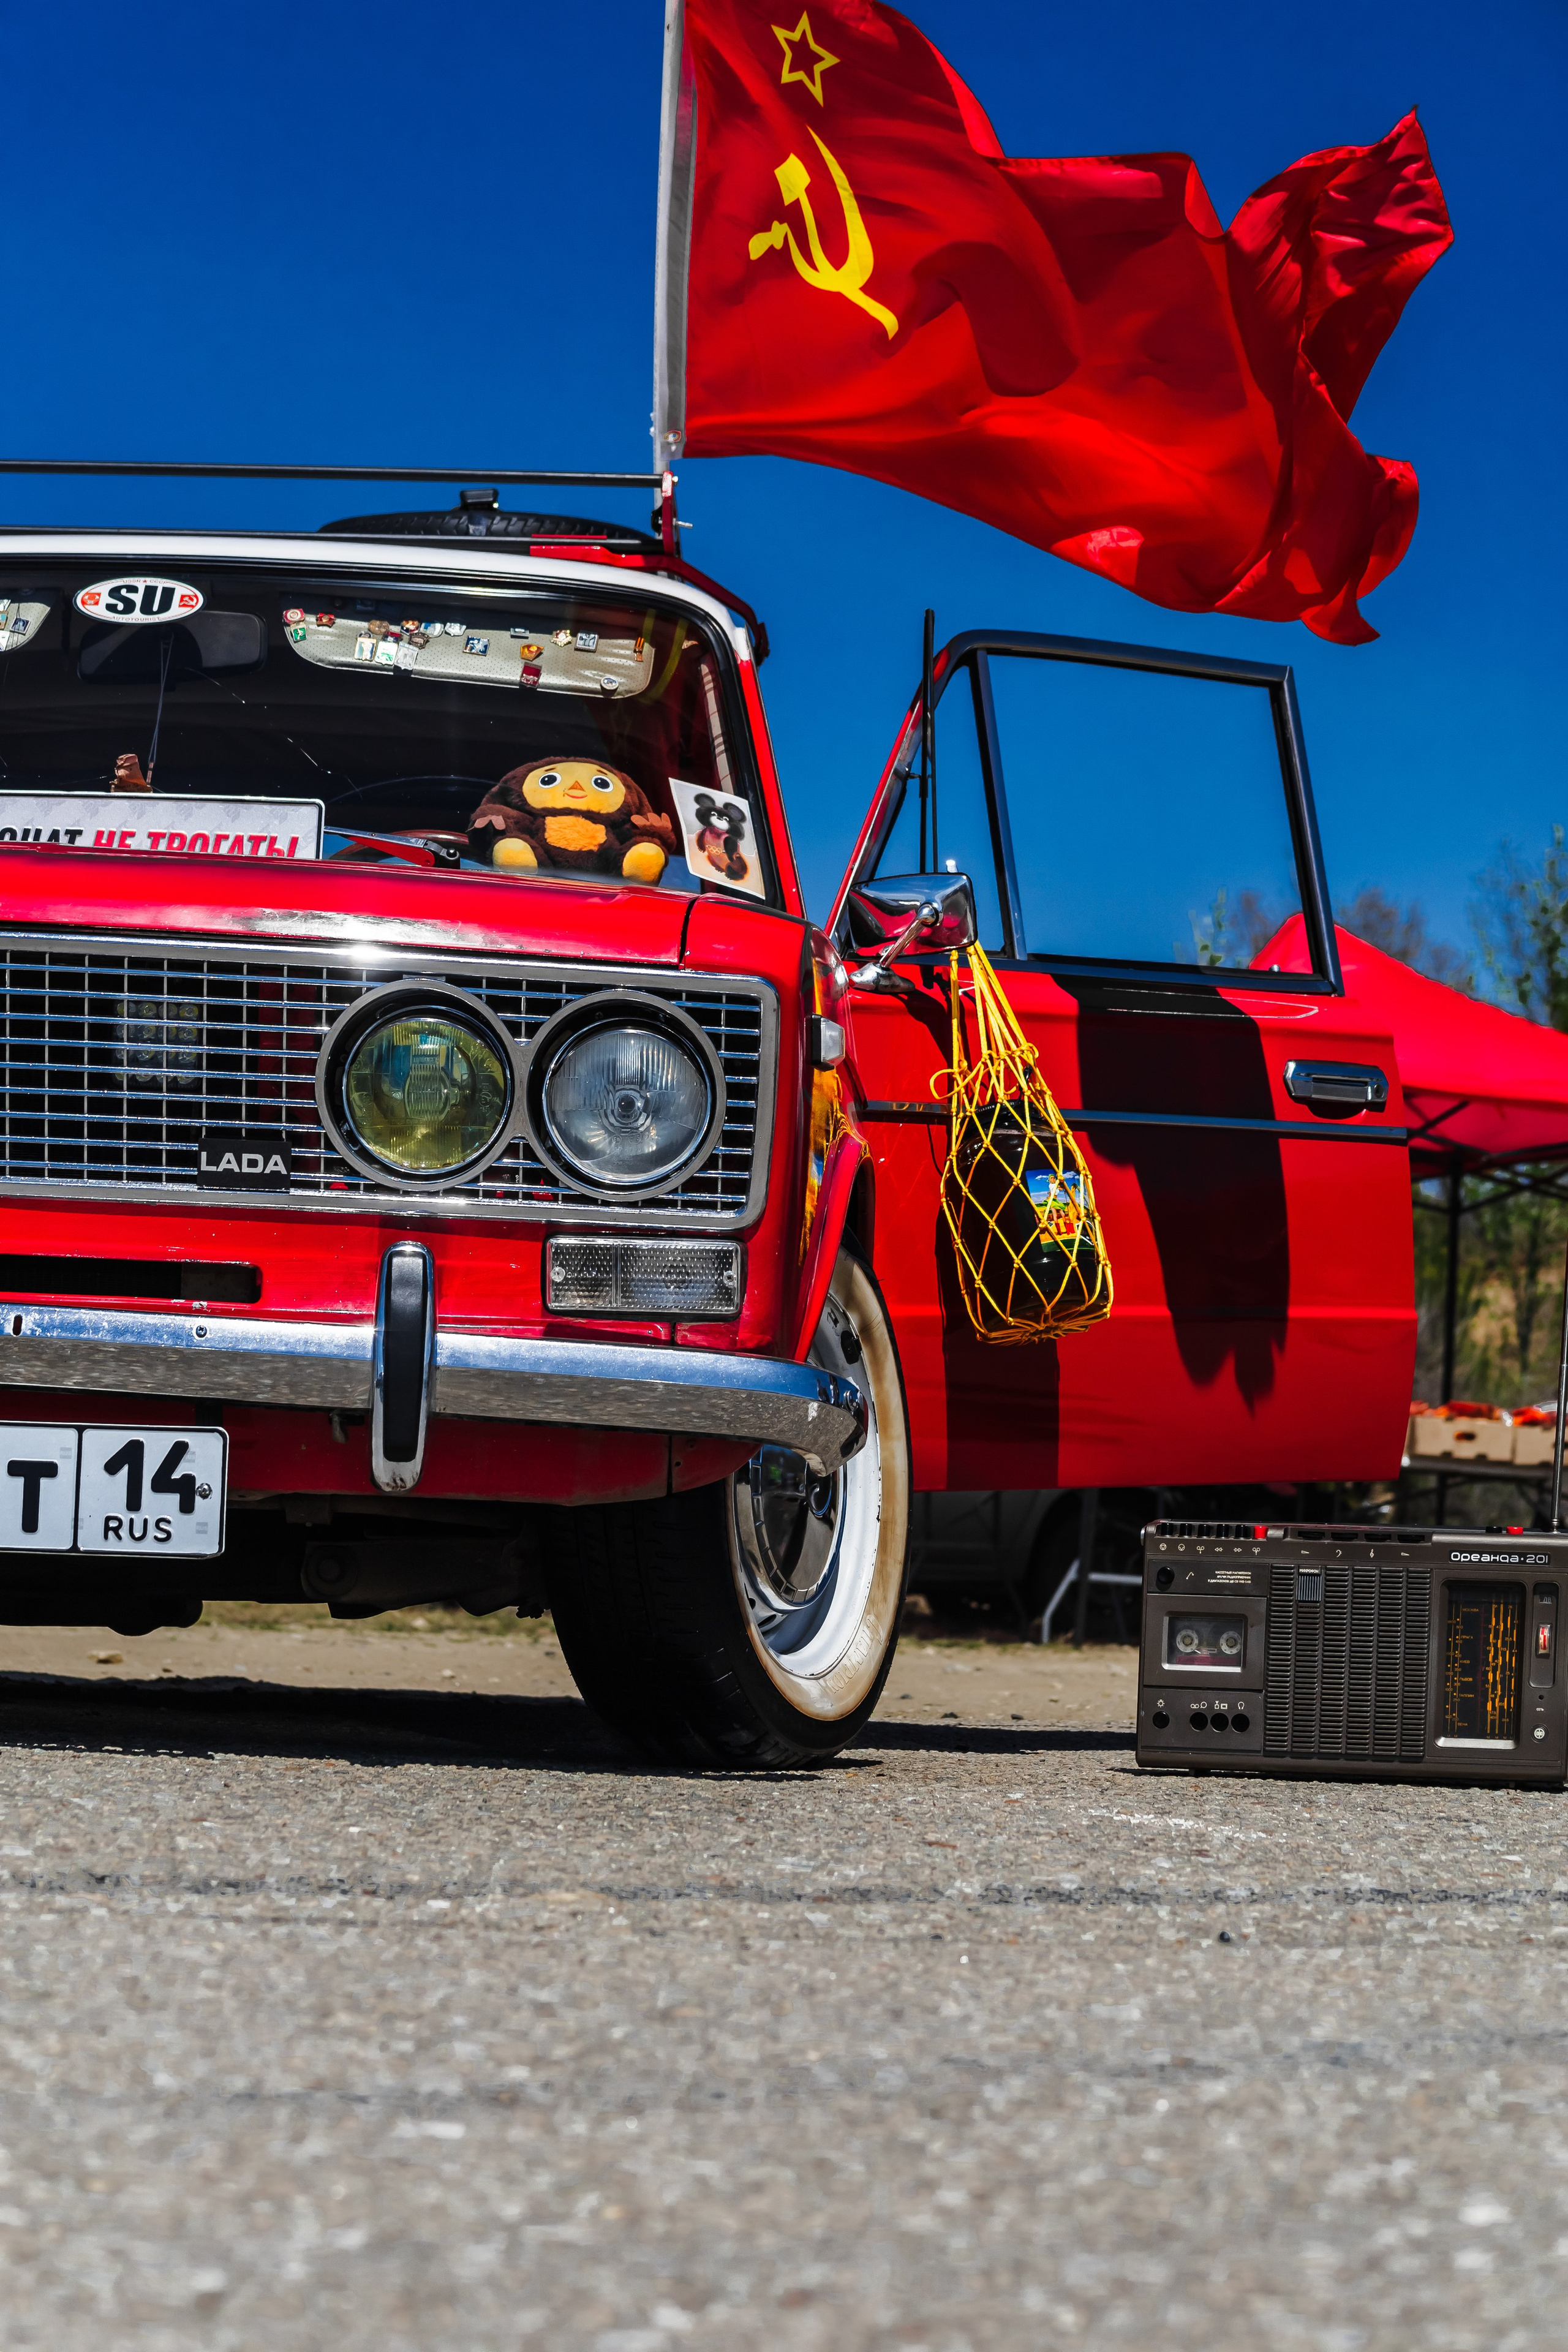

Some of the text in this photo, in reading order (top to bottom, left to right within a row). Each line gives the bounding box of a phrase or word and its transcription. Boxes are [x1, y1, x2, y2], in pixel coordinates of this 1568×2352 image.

[105, 584, 176, 616] SU
[93, 829, 136, 849] НЕ
[201, 1152, 287, 1174] LADA
[104, 1439, 196, 1514] 14
[103, 1515, 172, 1542] RUS
[827, 1614, 883, 1694] CHAMPION
